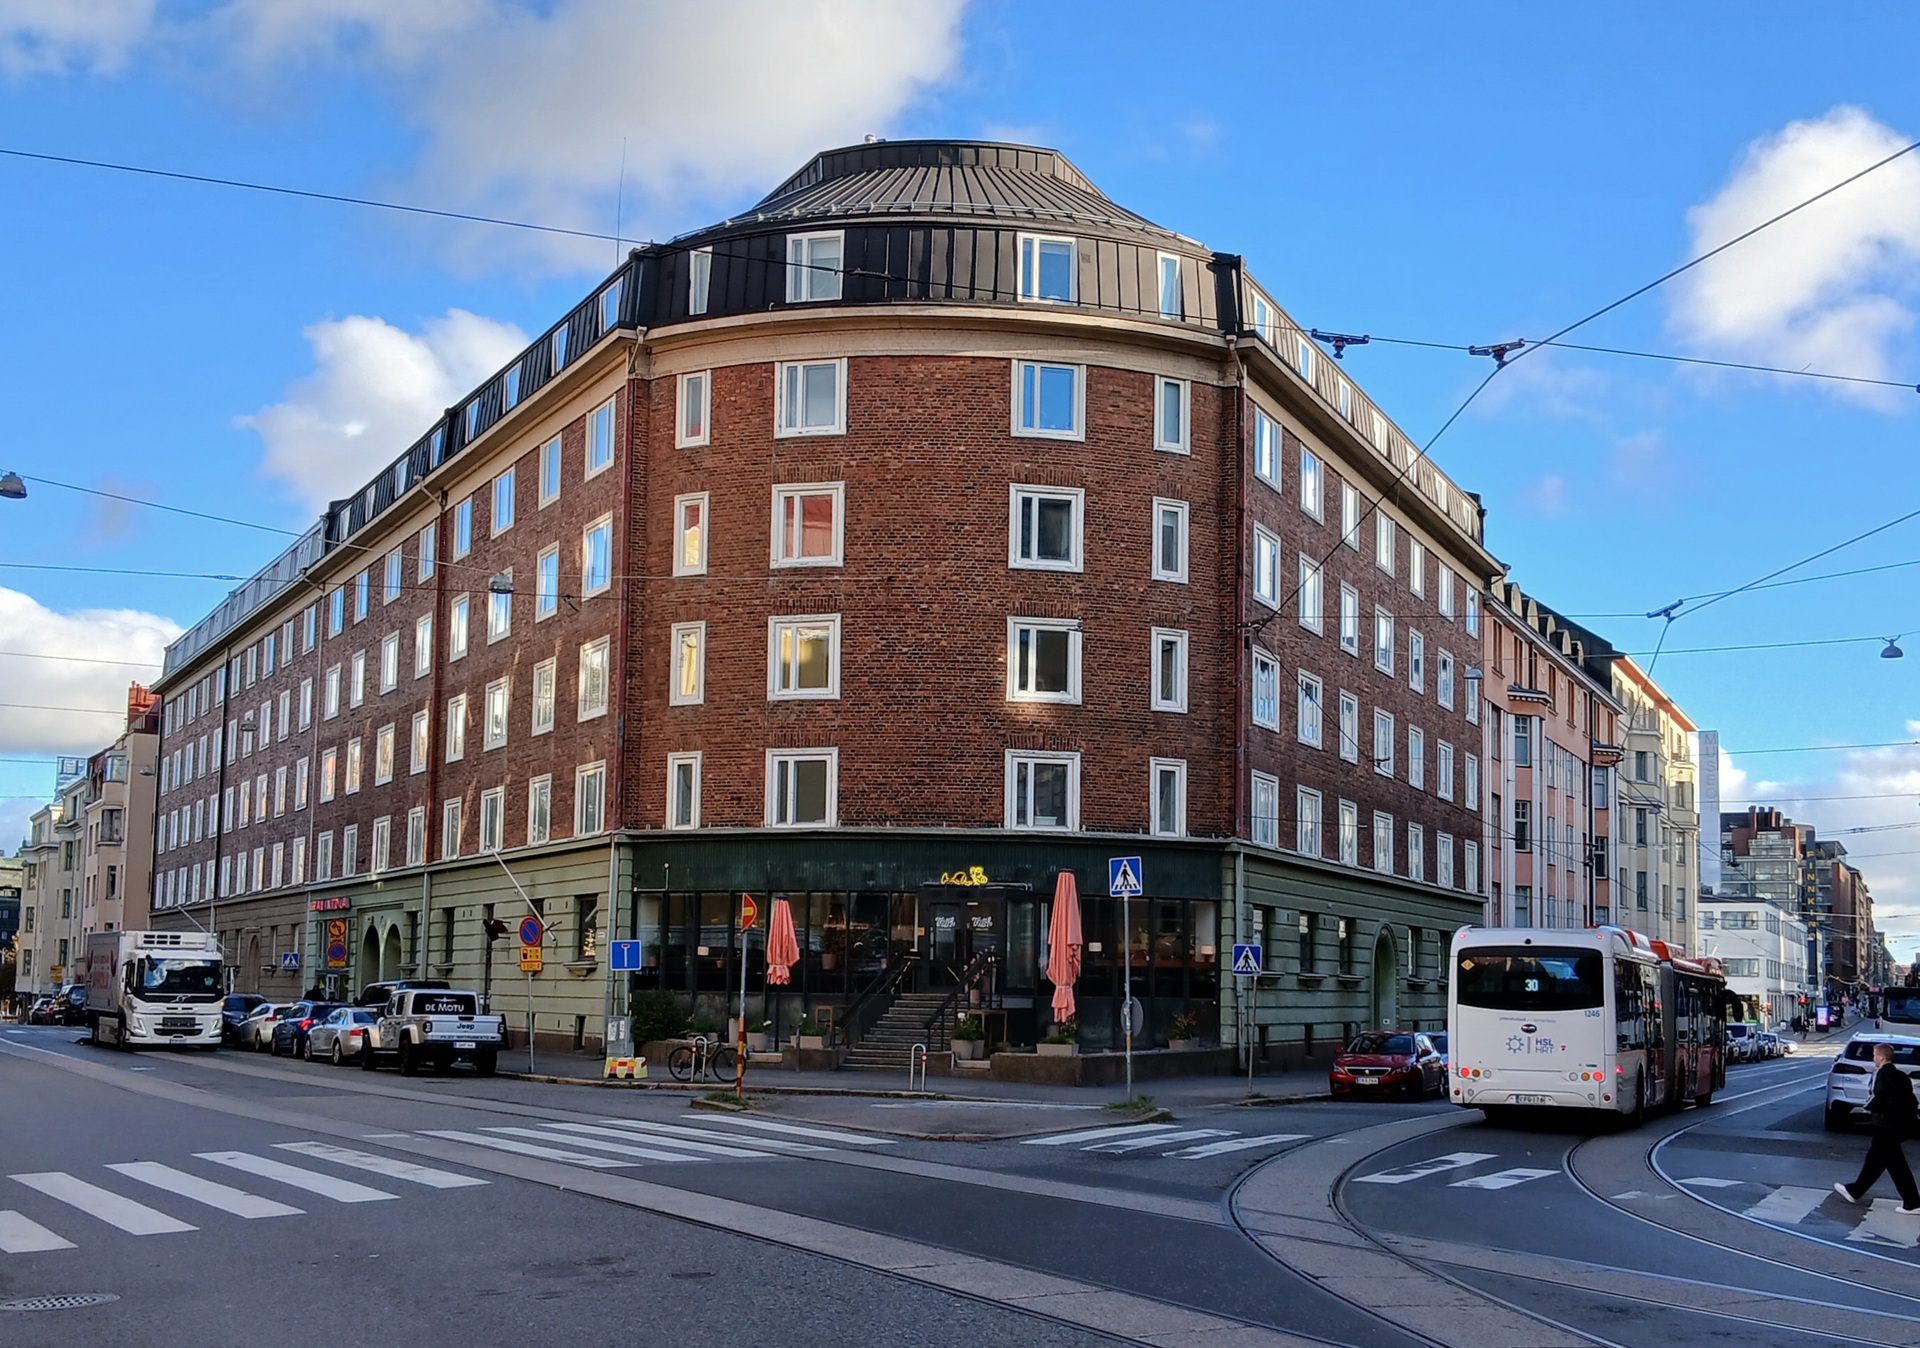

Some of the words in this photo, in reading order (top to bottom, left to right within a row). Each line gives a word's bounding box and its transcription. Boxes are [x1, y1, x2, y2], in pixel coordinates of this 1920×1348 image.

[1807, 850, 1816, 941] FINNKINO
[1524, 979, 1539, 992] 30
[425, 1003, 436, 1012] DE
[1584, 1010, 1600, 1018] 1246
[457, 1022, 475, 1031] Jeep
[1535, 1038, 1554, 1047] HSL
[1535, 1046, 1554, 1055] HRT
